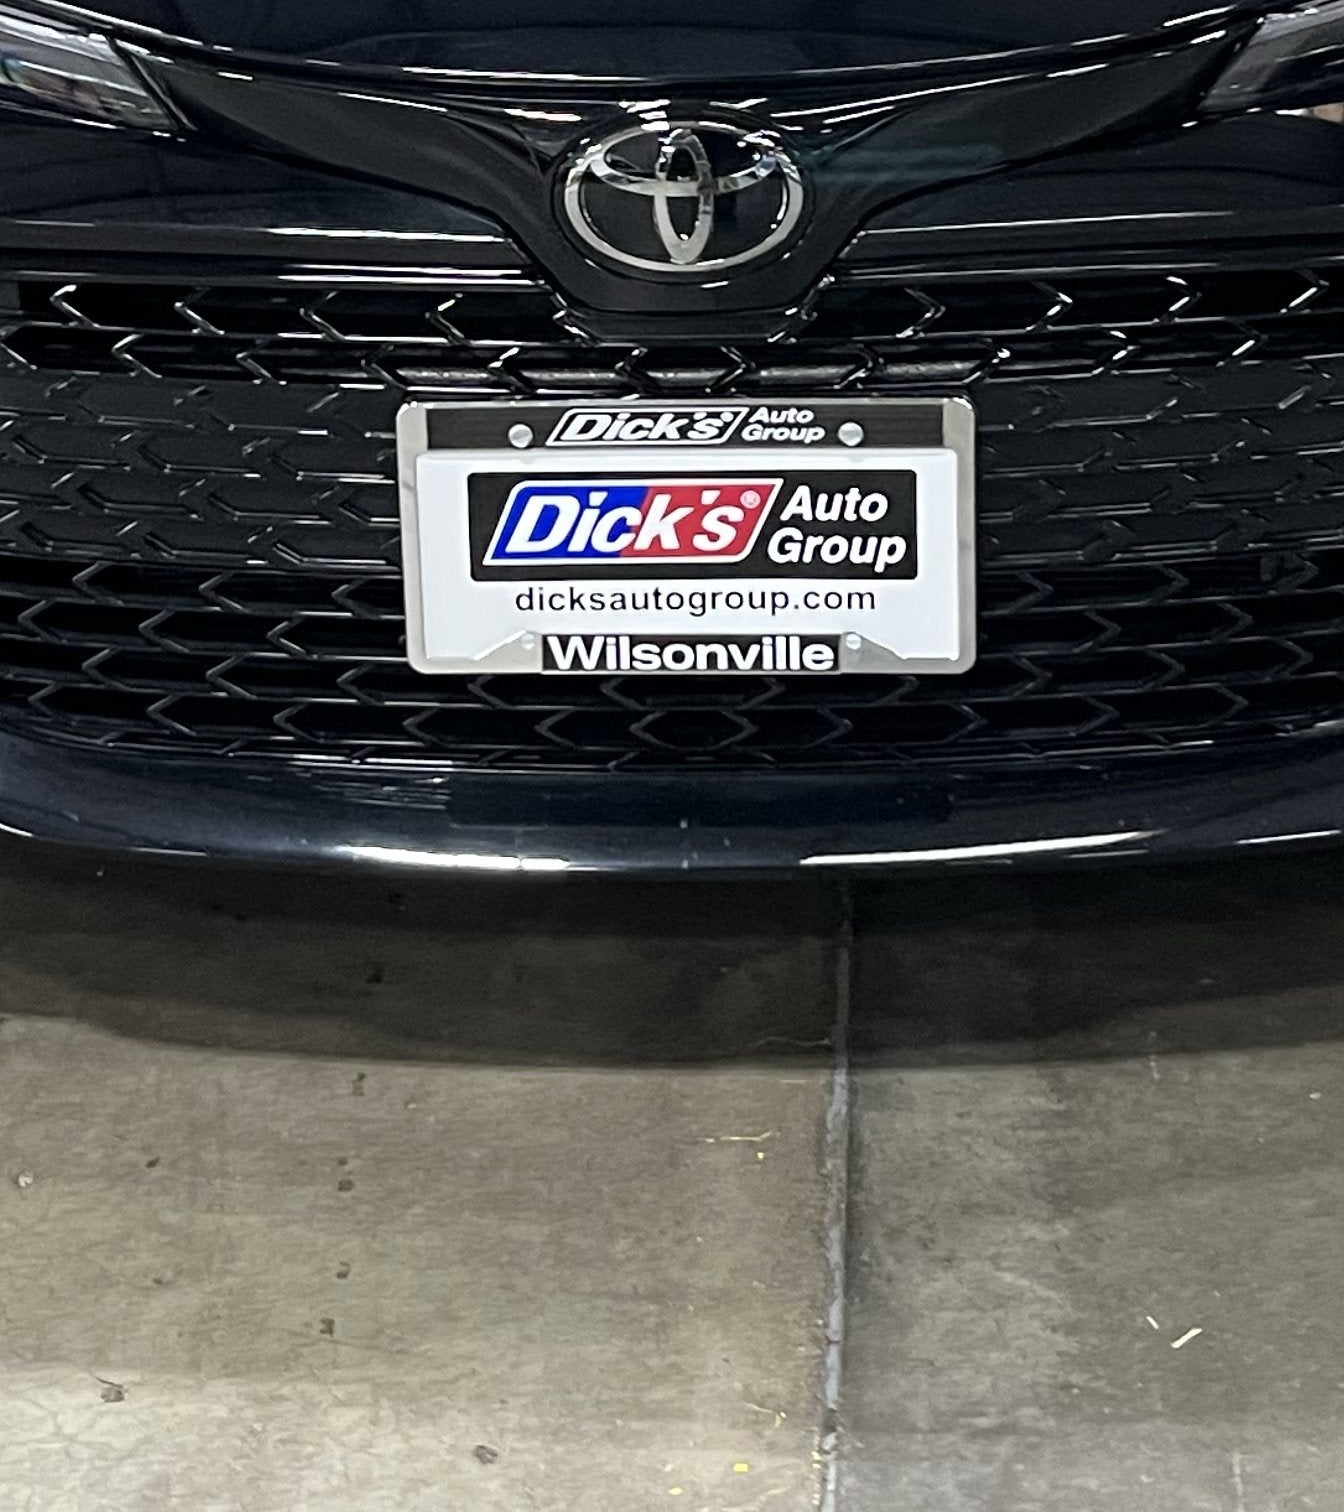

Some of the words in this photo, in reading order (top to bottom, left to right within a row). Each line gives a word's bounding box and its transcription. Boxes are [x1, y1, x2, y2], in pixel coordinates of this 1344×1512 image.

[559, 411, 724, 441] Dick's
[749, 406, 814, 424] Auto
[741, 425, 826, 444] Group
[779, 485, 889, 522] Auto
[504, 490, 745, 553] Dick's
[767, 528, 906, 573] Group
[515, 586, 876, 616] dicksautogroup.com
[547, 634, 835, 671] Wilsonville
